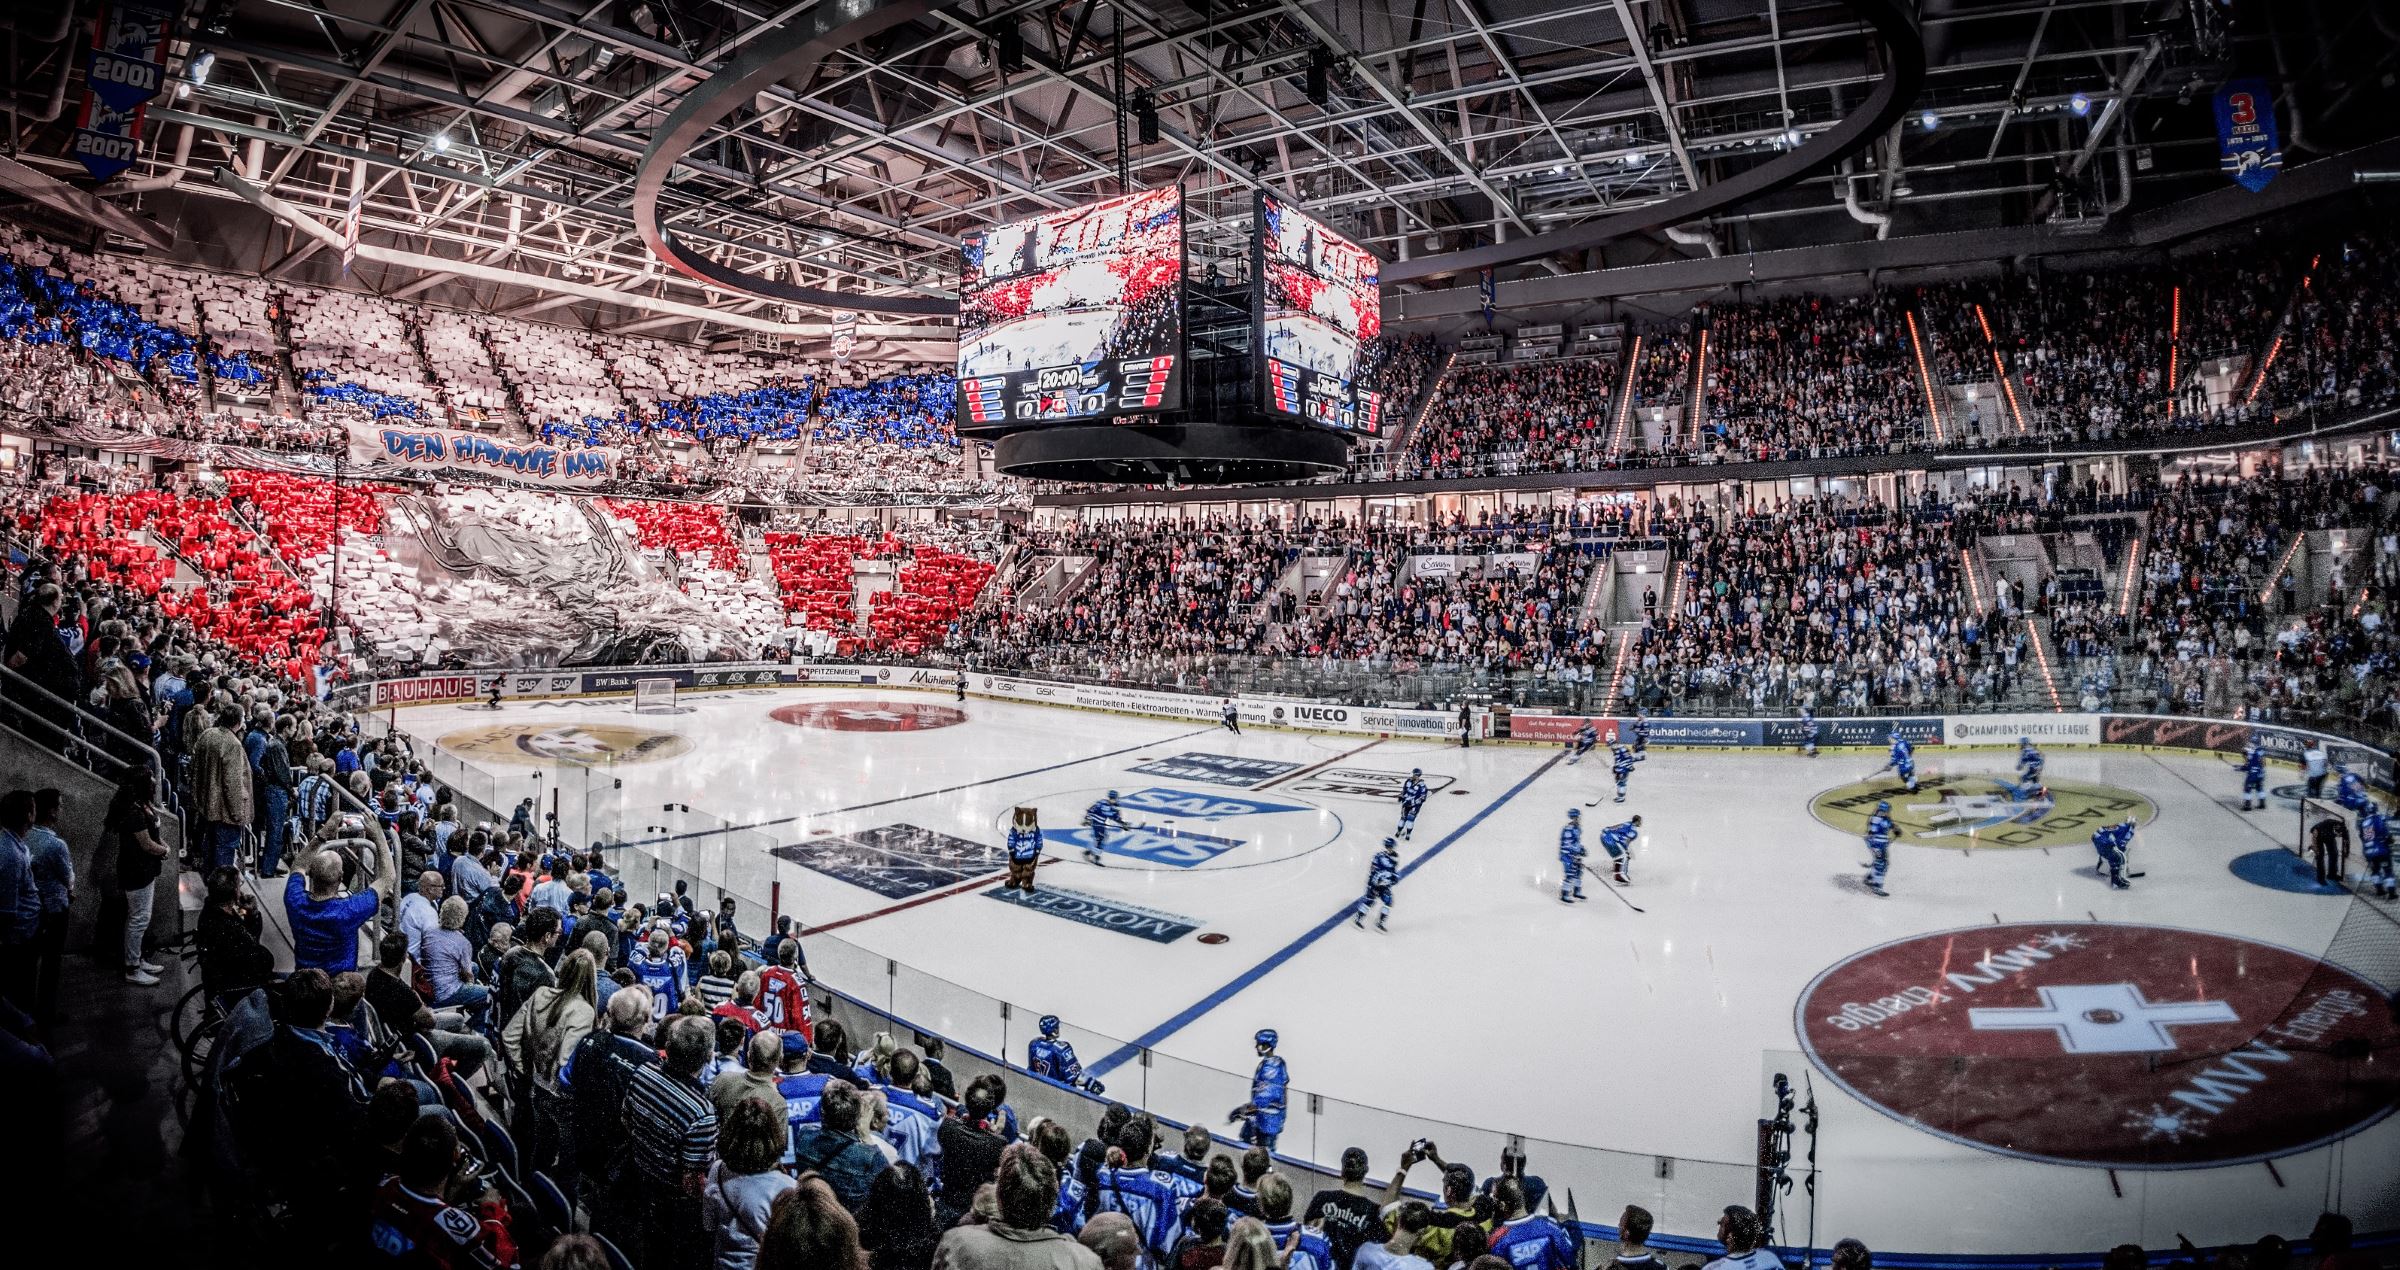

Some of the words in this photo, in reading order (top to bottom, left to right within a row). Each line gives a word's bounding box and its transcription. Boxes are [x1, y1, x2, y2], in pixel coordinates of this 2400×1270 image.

[93, 57, 155, 90] 2001
[2230, 92, 2256, 124] 3
[76, 133, 134, 161] 2007
[1043, 368, 1078, 388] 20:00
[1024, 402, 1032, 415] 0
[1088, 396, 1096, 410] 0
[1311, 401, 1318, 415] 0
[1343, 412, 1350, 424] 0
[380, 429, 448, 462] DEN
[596, 678, 608, 687] BW
[611, 677, 629, 686] Bank
[700, 674, 719, 683] AOK
[728, 673, 747, 682] AOK
[756, 672, 777, 681] AOK
[909, 670, 969, 691] Mühlenbg
[377, 678, 475, 704] BAUHAUS
[517, 680, 536, 690] SAP
[552, 679, 571, 689] SAP
[997, 683, 1016, 693] GSK
[1036, 687, 1056, 697] GSK
[1076, 696, 1125, 709] Malerarbeiten
[1131, 702, 1189, 715] Elektroarbeiten
[1195, 708, 1266, 723] Wärmemung
[1294, 706, 1348, 722] IVECO
[1363, 715, 1395, 727] service
[1397, 717, 1444, 729] innovation
[1446, 721, 1460, 733] gro
[1838, 727, 1876, 735] PEKKIP
[1898, 726, 1937, 734] PEKKIP
[1969, 724, 2019, 737] CHAMPIONS
[2021, 723, 2054, 736] HOCKEY
[2057, 723, 2090, 736] LEAGUE
[1510, 731, 1533, 739] rkasse
[1534, 731, 1554, 740] Rhein
[1649, 727, 1740, 739] euhandheidelberg
[1129, 790, 1258, 816] SAP
[1996, 799, 2137, 846] RADIO
[1003, 888, 1181, 936] MORGEN
[1944, 943, 2054, 994] MVV
[643, 977, 665, 989] SAP
[768, 978, 786, 991] SAP
[763, 992, 784, 1024] 50
[1826, 985, 1952, 1031] Energie
[2169, 1037, 2294, 1115] MVV
